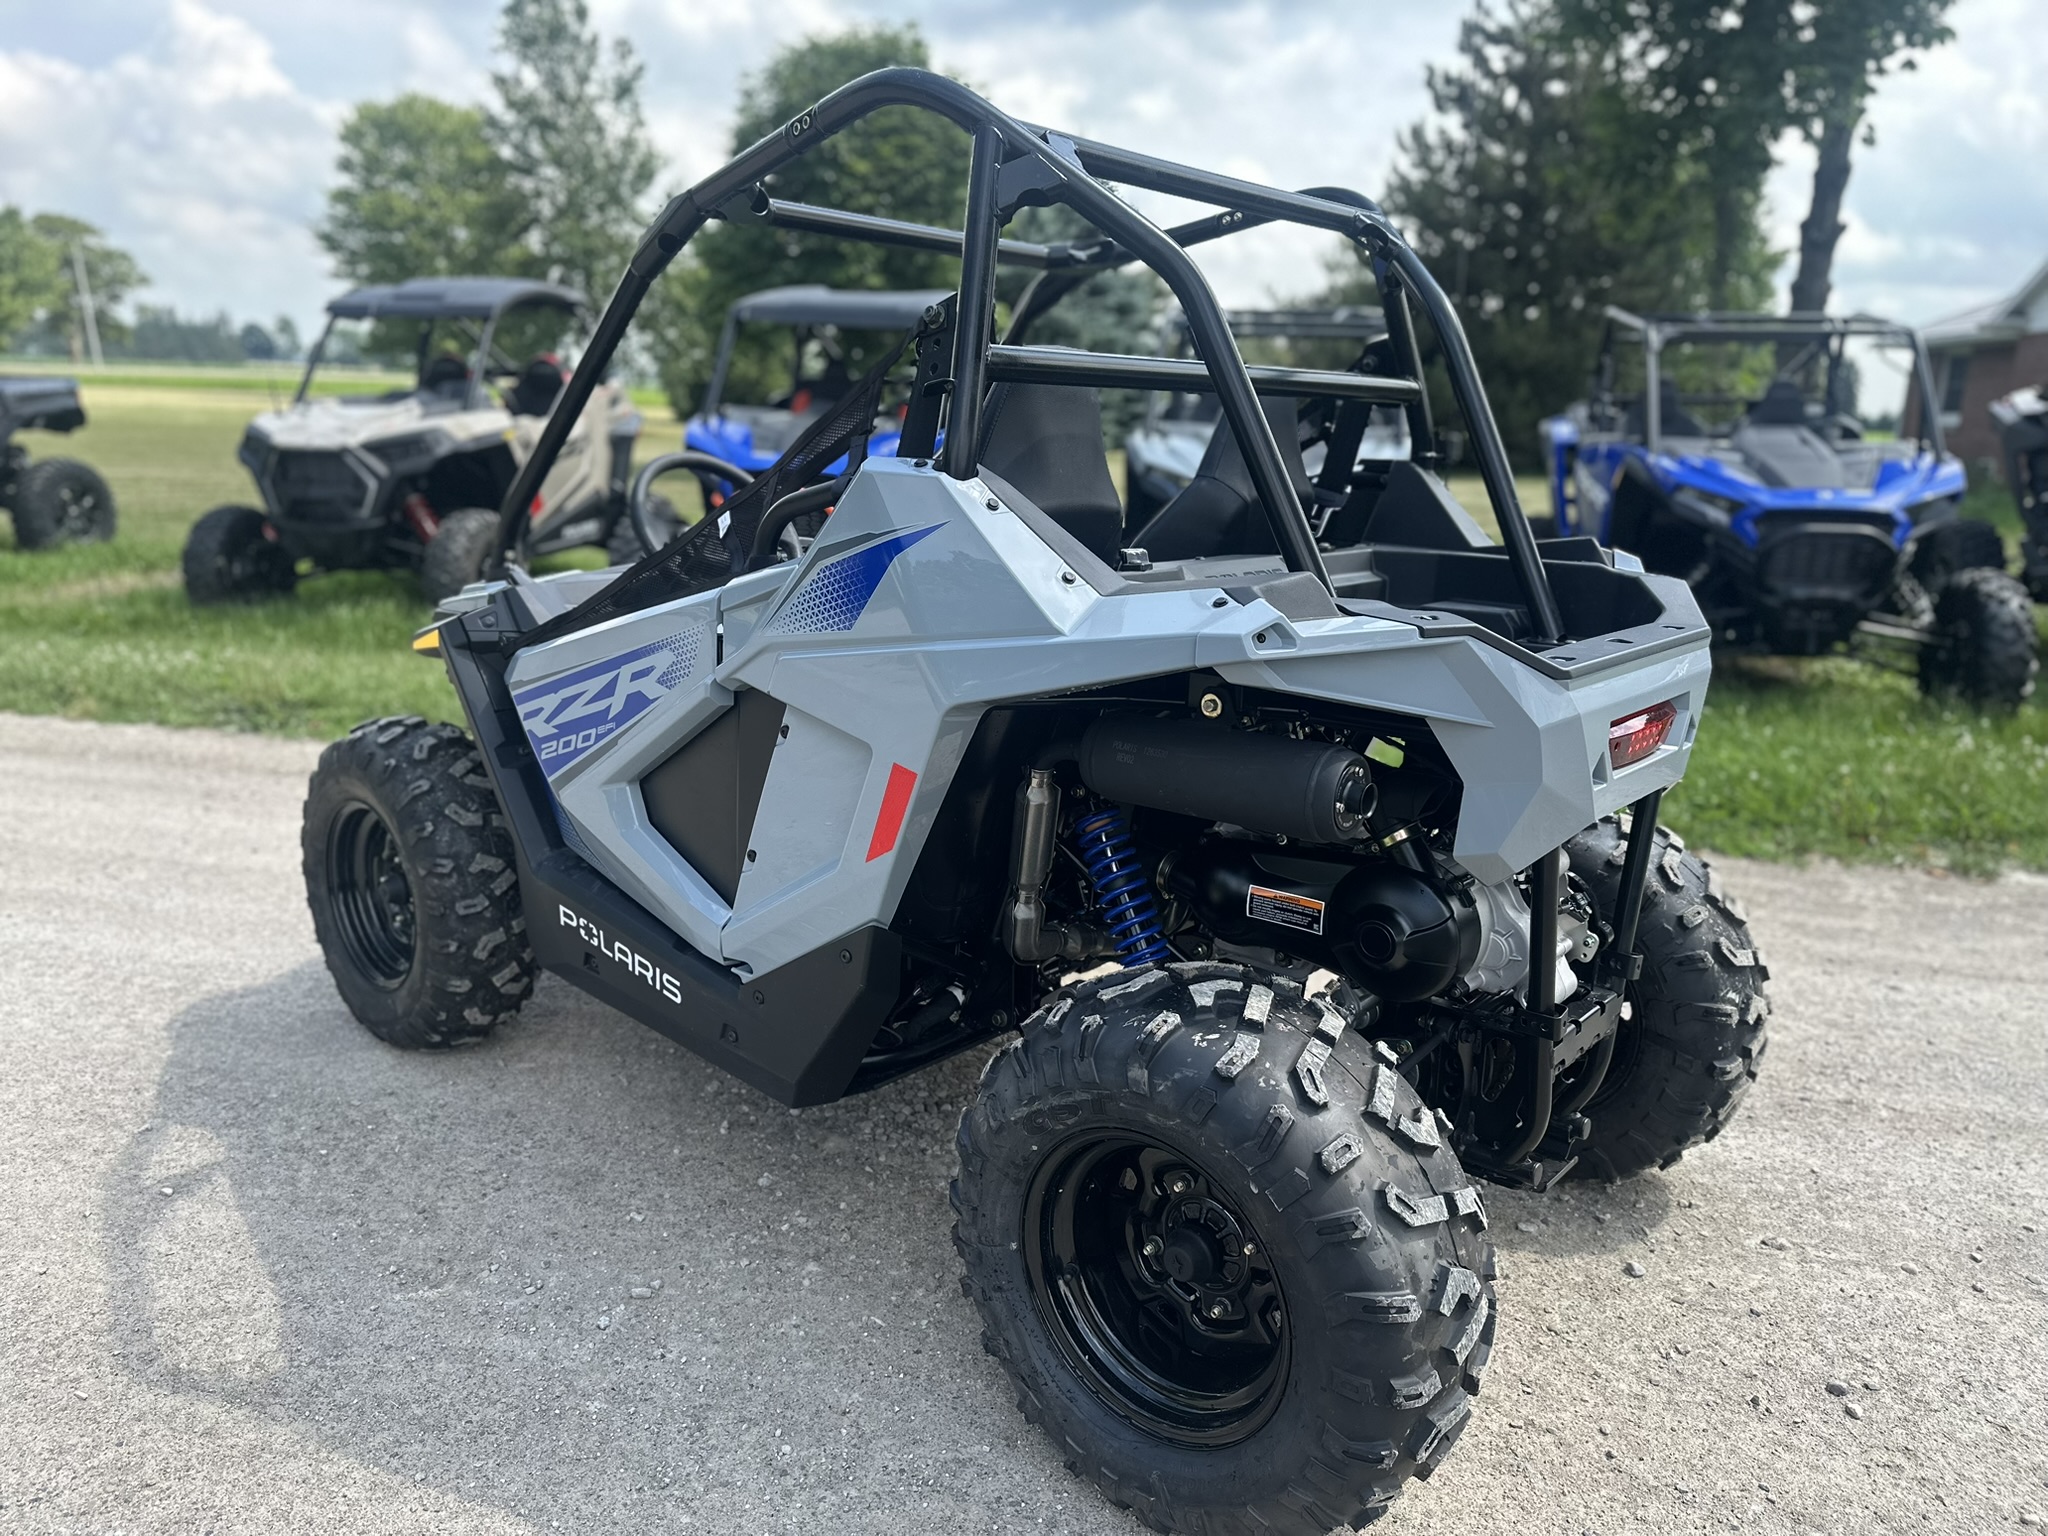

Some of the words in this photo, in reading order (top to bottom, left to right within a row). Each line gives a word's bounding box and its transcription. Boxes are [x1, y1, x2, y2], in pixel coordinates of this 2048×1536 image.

[517, 649, 678, 738] RZR
[1112, 740, 1138, 753] POLARIS
[1278, 895, 1301, 904] WARNING
[559, 904, 682, 1004] POLARIS
